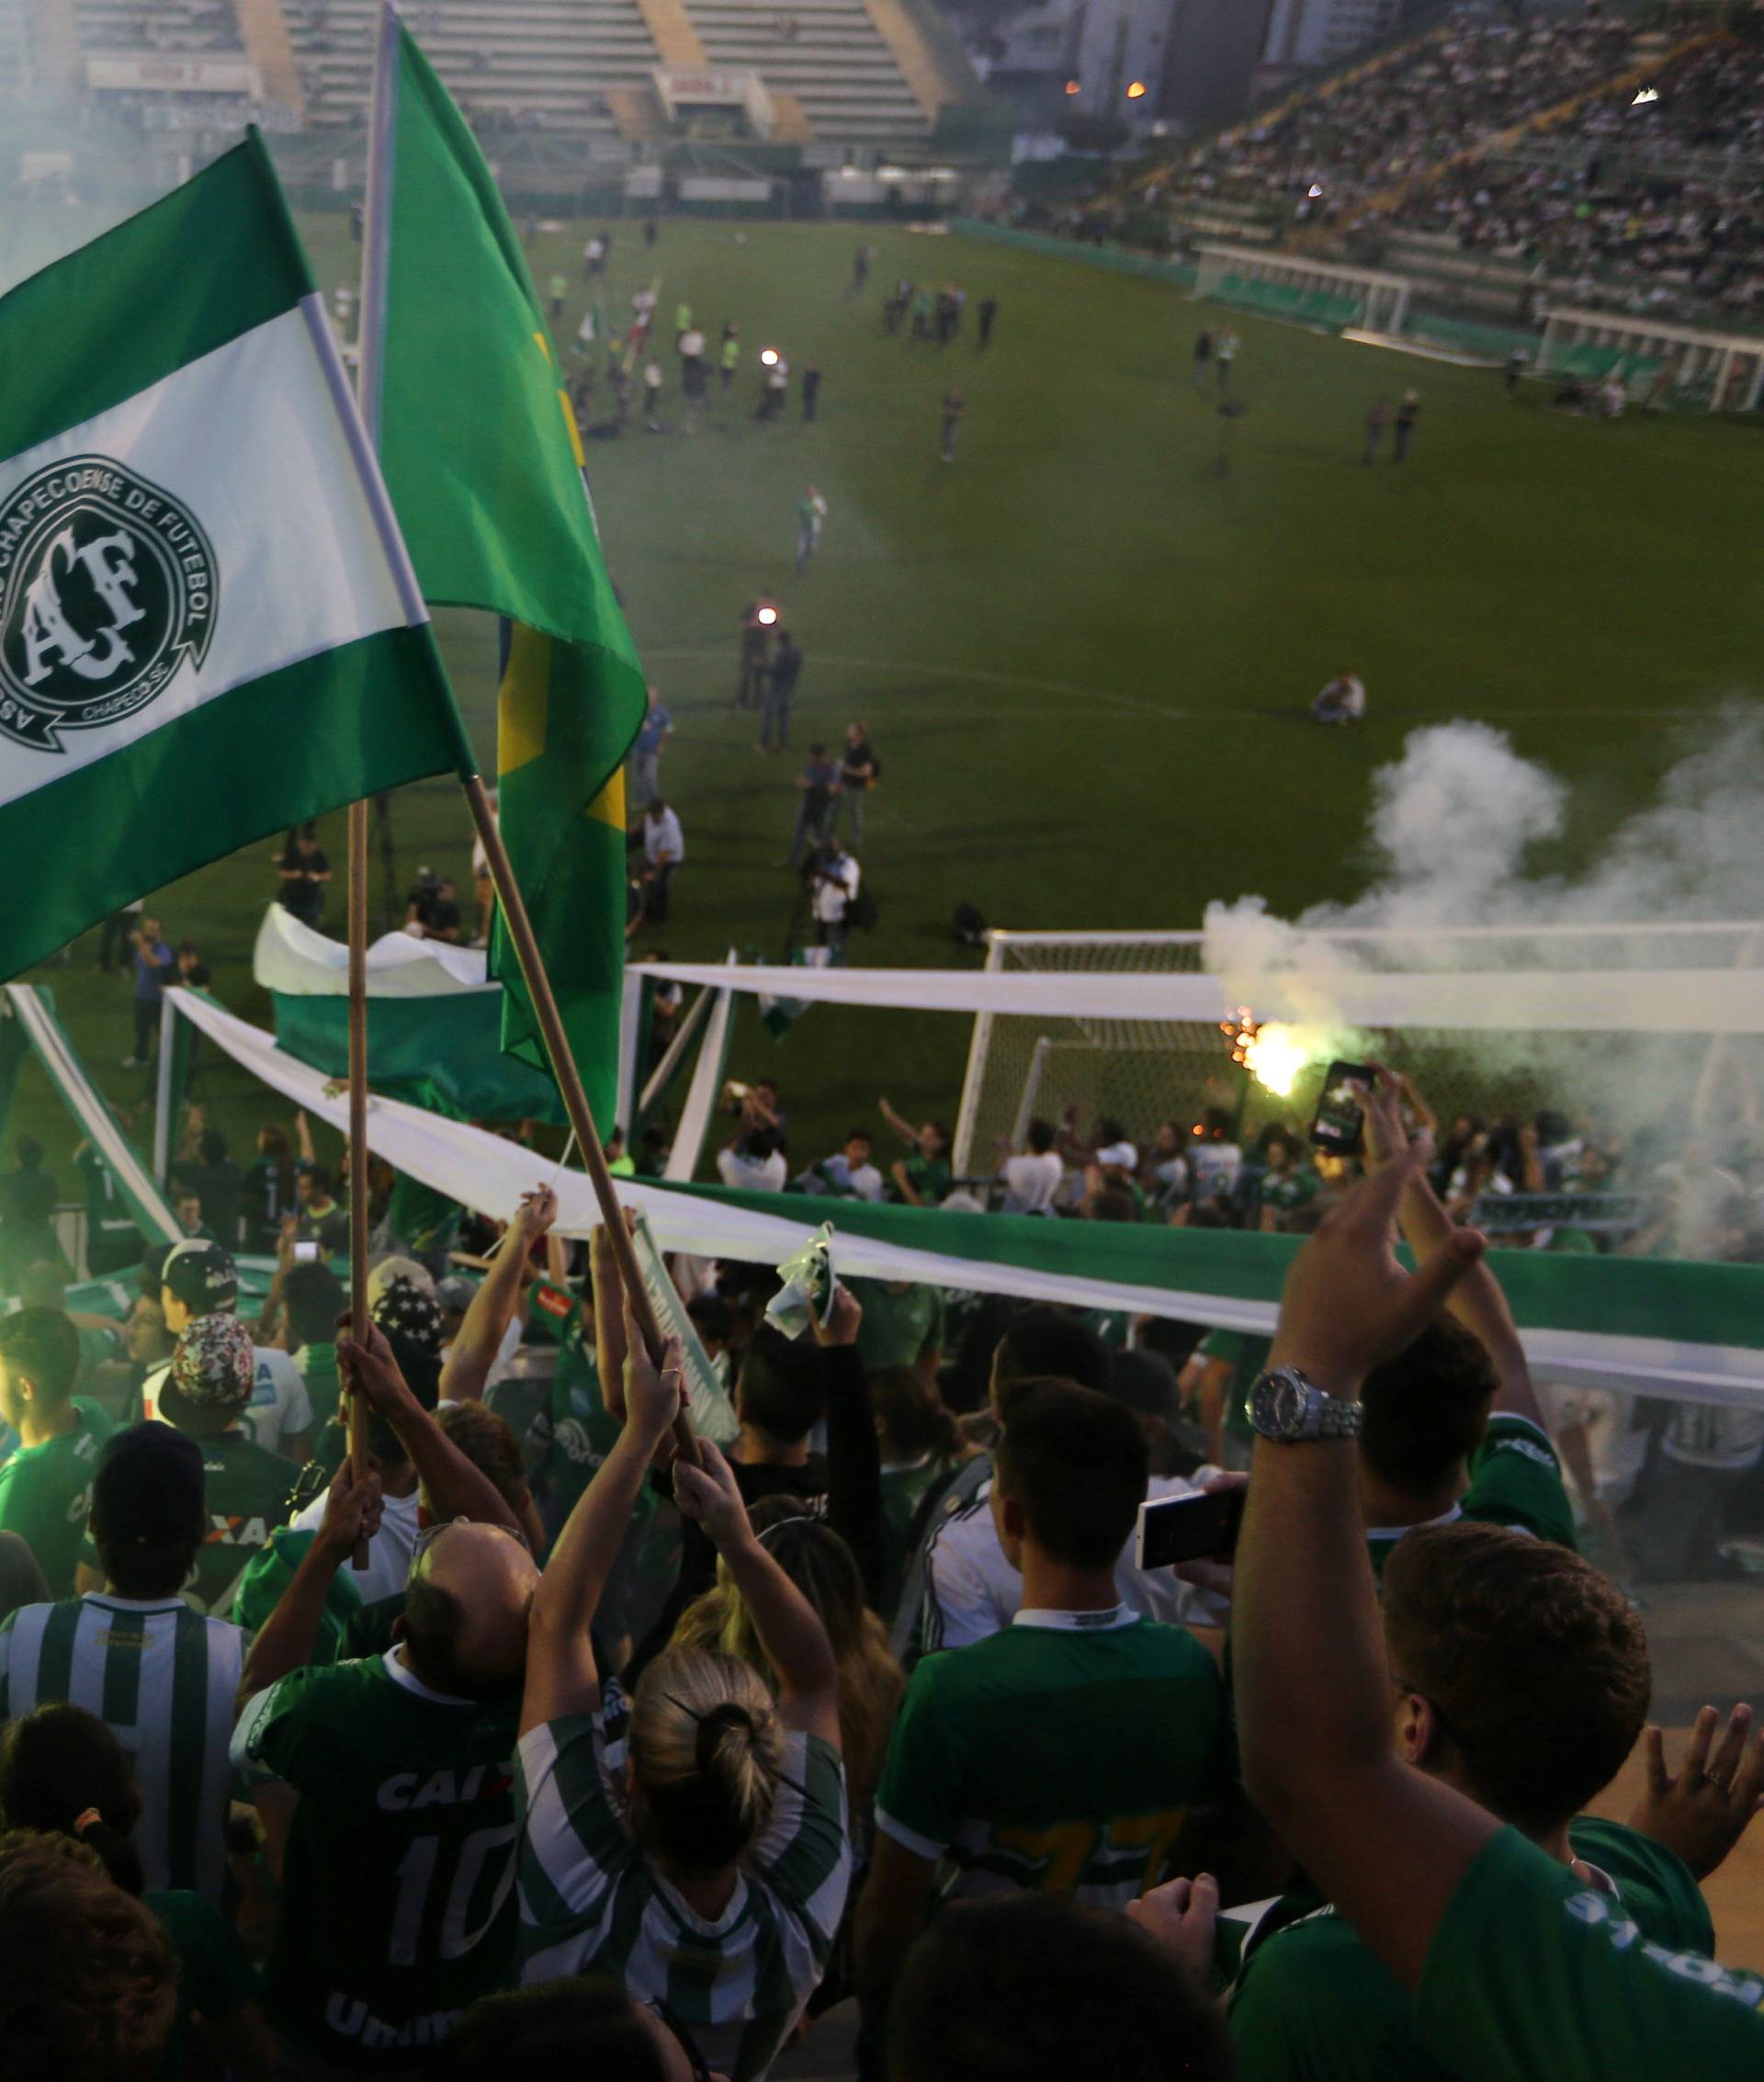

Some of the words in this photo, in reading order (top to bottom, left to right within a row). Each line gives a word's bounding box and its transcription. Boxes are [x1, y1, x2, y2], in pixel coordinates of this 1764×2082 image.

[0, 469, 125, 568] CHAPECOENSE
[126, 489, 163, 519] DE
[158, 512, 209, 628] FUTEBOL
